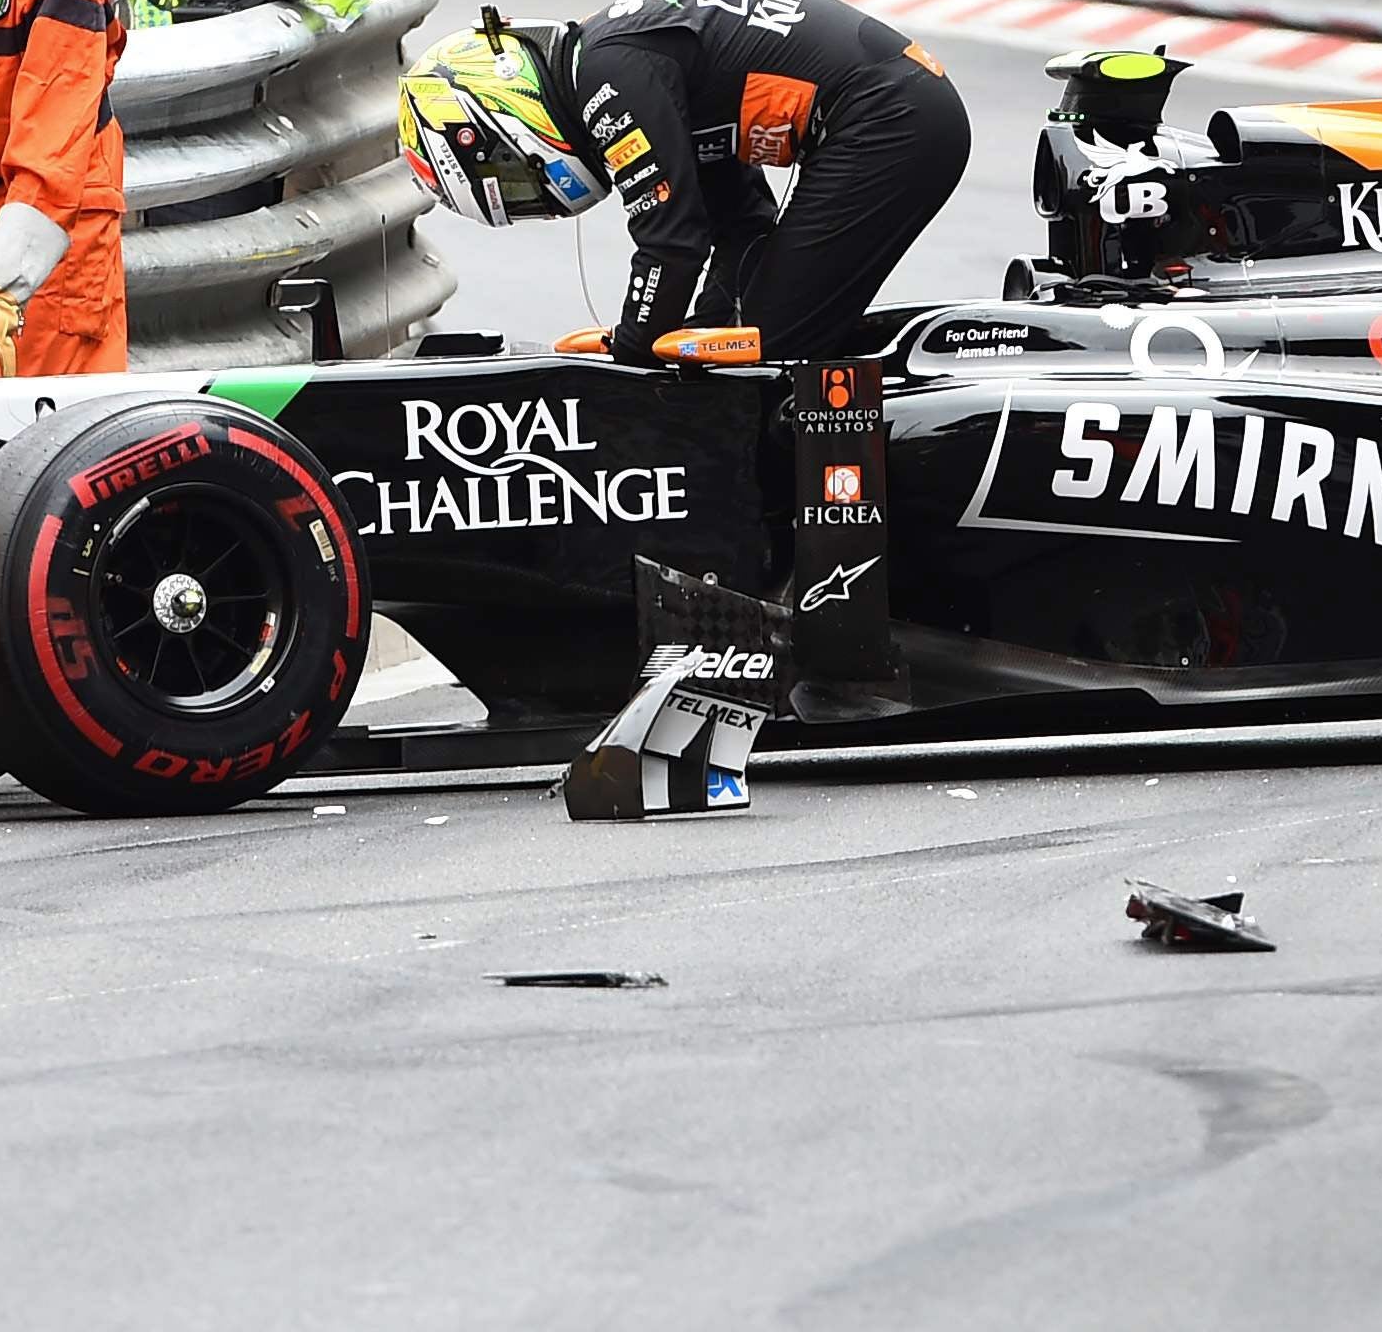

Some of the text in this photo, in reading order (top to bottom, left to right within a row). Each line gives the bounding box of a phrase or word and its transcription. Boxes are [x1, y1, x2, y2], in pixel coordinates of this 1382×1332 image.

[642, 264, 663, 305] STEEL
[945, 325, 1029, 343] For Our Friend
[701, 339, 757, 352] TELMEX
[955, 345, 997, 360] James
[797, 409, 880, 423] CONSORCIO
[401, 398, 597, 475] ROYAL
[804, 421, 875, 434] ARISTOS
[67, 420, 213, 510] PIRELLI
[803, 505, 883, 525] FICREA
[666, 692, 759, 732] TELMEX
[133, 709, 312, 784] ZERO
